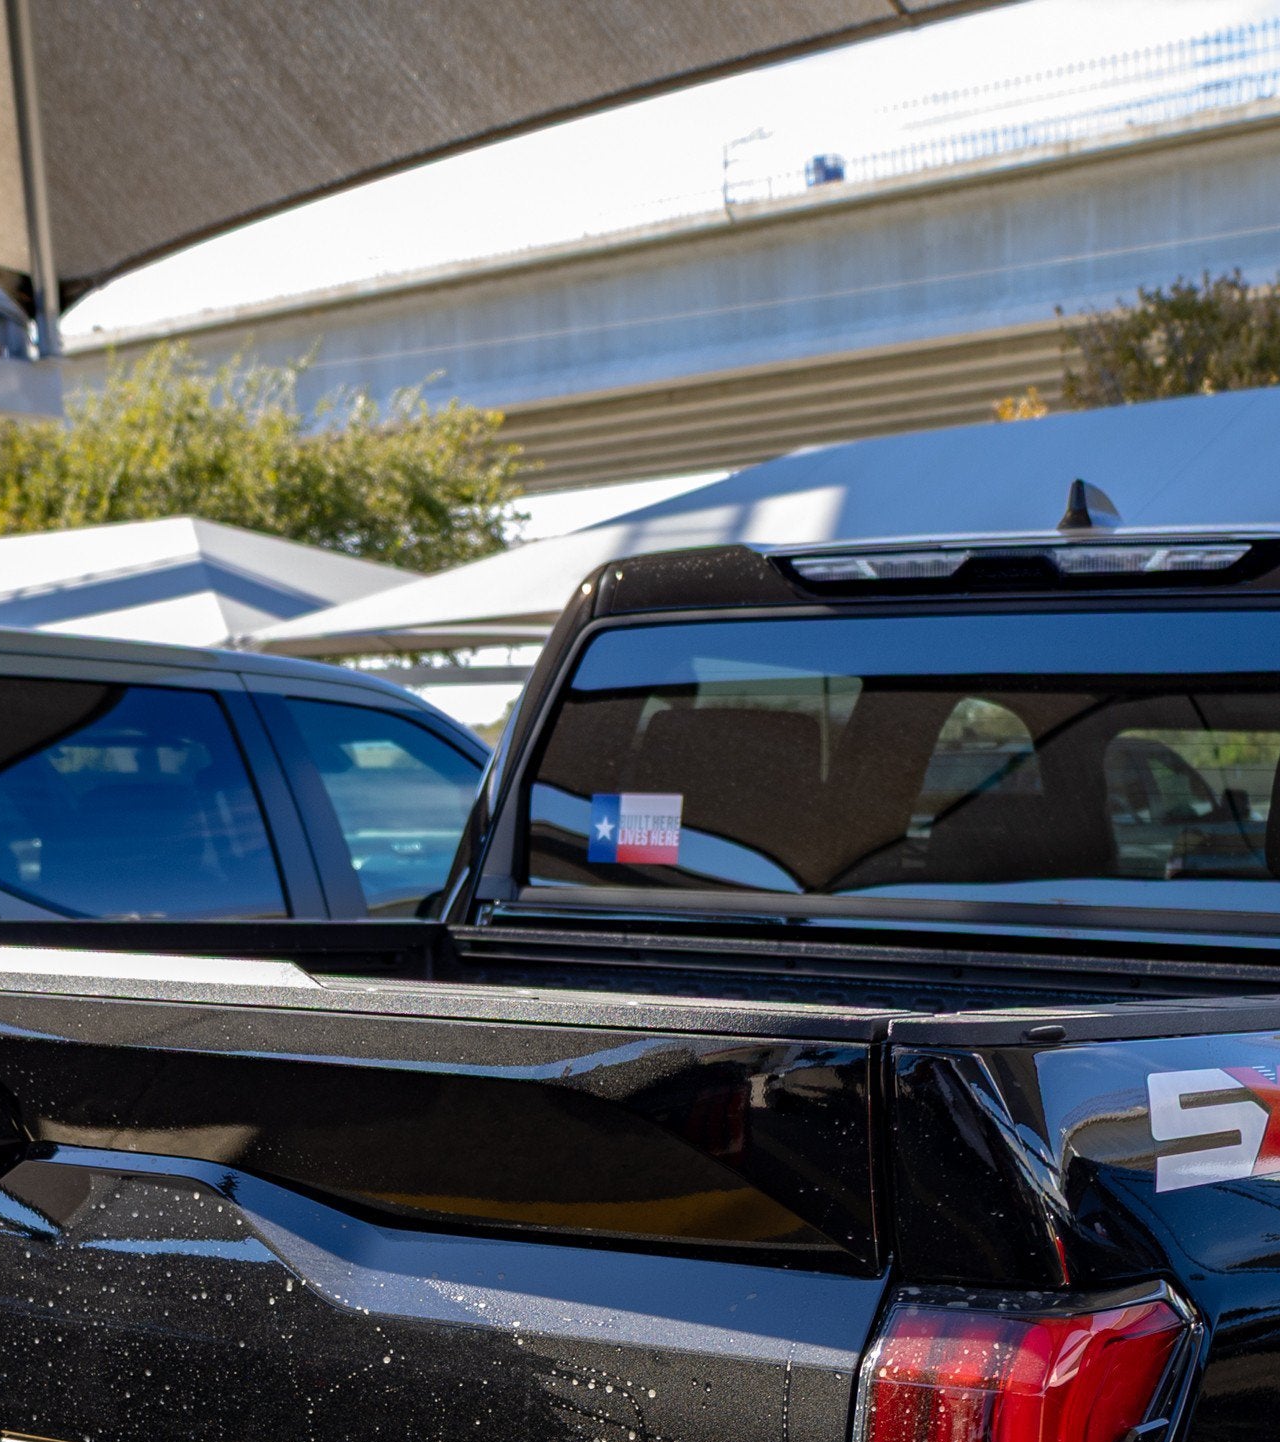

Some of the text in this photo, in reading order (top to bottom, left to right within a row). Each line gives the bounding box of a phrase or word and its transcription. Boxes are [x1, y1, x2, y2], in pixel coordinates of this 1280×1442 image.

[620, 815, 680, 831] BUILT HERE
[618, 828, 680, 847] LIVES HERE
